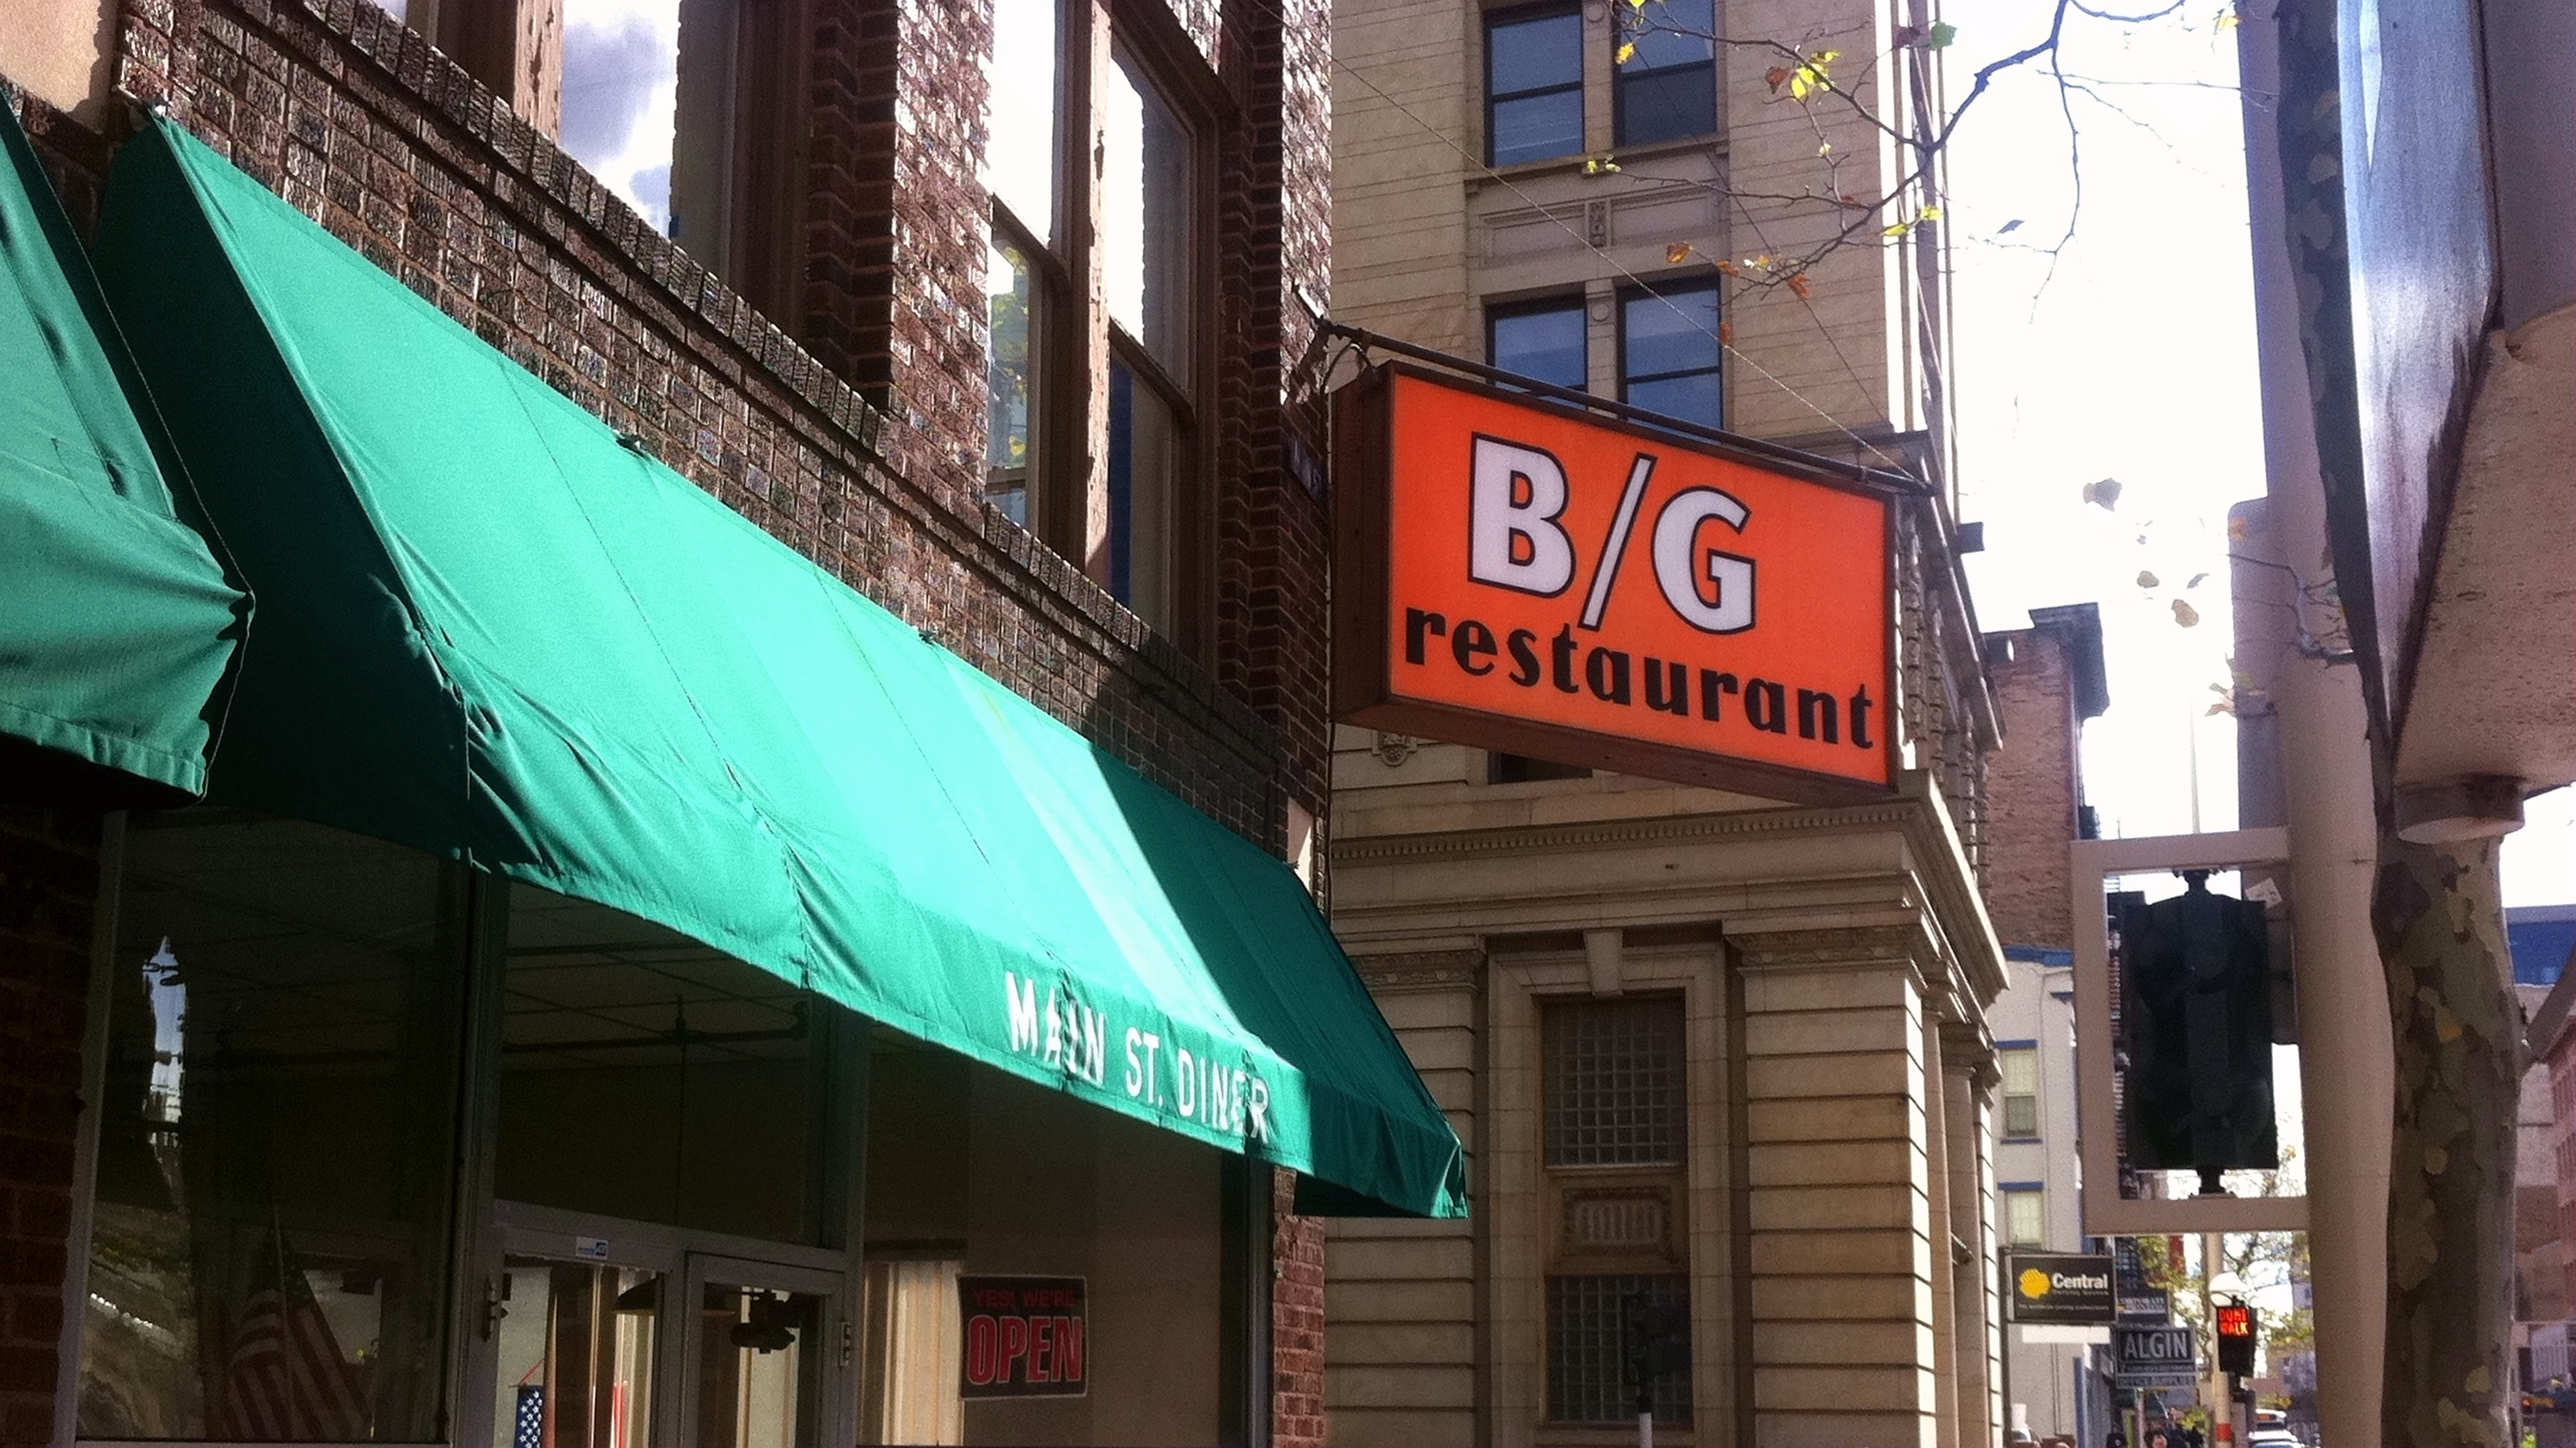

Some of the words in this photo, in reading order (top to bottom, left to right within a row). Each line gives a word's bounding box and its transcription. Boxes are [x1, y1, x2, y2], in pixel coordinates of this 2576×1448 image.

[1468, 432, 1756, 634] B/G
[1405, 607, 1872, 750] restaurant
[1005, 971, 1106, 1086] MAIN
[1126, 1026, 1164, 1107] ST.
[1178, 1048, 1269, 1144] DINER
[2052, 1272, 2108, 1289] Central
[967, 1315, 1082, 1386] OPEN
[2125, 1332, 2188, 1359] ALGIN
[2220, 1321, 2248, 1335] WALK
